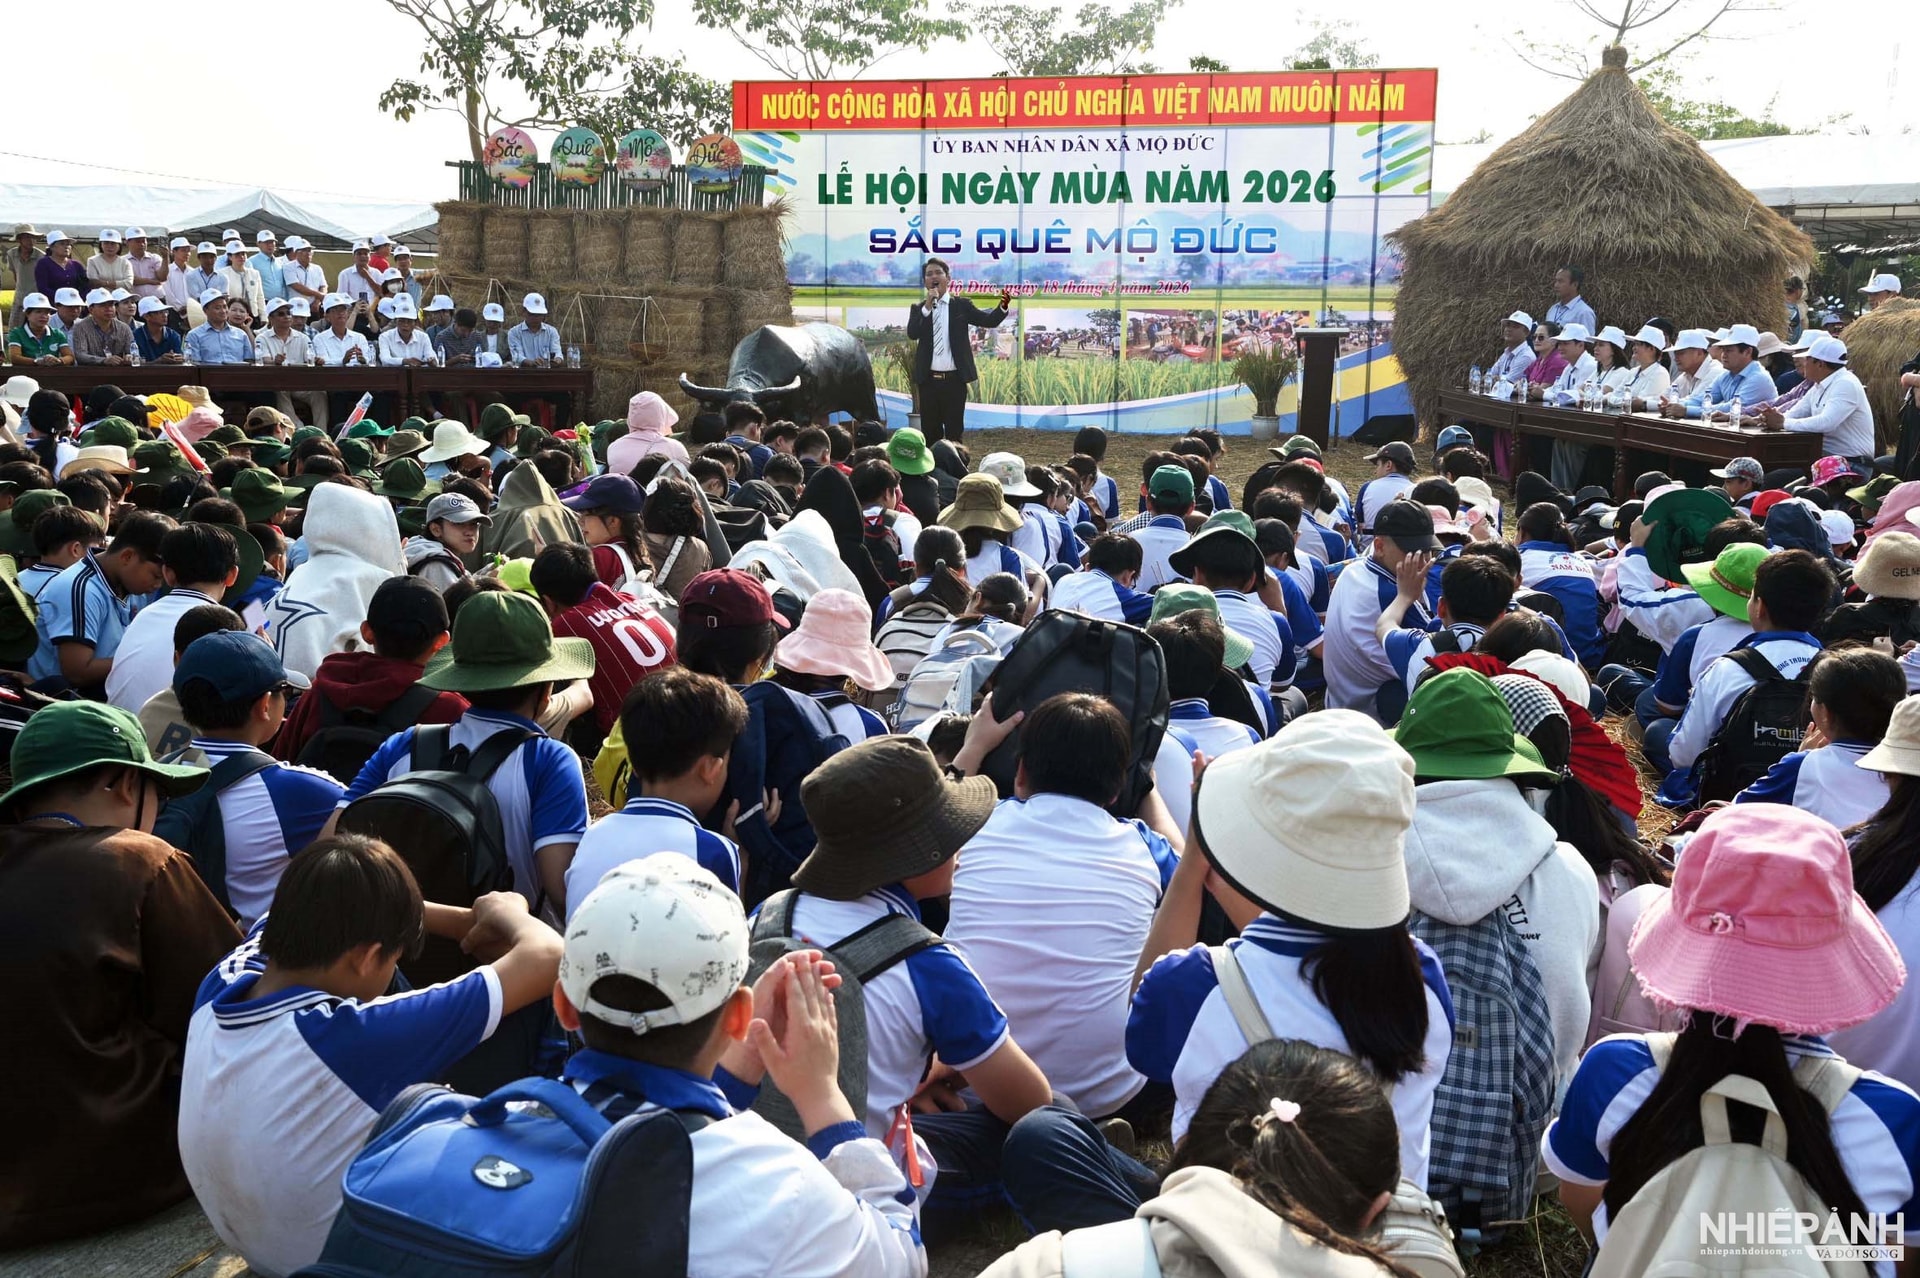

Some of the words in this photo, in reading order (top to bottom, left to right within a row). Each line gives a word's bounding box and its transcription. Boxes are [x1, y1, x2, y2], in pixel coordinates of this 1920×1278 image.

[762, 89, 820, 119] NƯỚC
[827, 88, 885, 124] CỘNG
[893, 87, 936, 118] HÒA
[943, 87, 973, 117] XÃ
[979, 86, 1016, 122] HỘI
[1024, 82, 1067, 116] CHỦ
[1076, 83, 1145, 116] NGHĨA
[1152, 82, 1201, 120] VIỆT
[1208, 86, 1262, 113] NAM
[1270, 80, 1341, 113] MUÔN
[1348, 78, 1405, 111] NĂM
[491, 132, 523, 158] Sắc
[557, 137, 594, 156] Quê
[629, 136, 655, 165] Mộ
[689, 137, 725, 166] Đức
[933, 137, 957, 154] ỦY
[962, 140, 999, 154] BAN
[1004, 135, 1056, 153] NHÂN
[1061, 135, 1100, 152] DÂN
[1105, 135, 1131, 152] XÃ
[1137, 134, 1168, 155] MỘ
[1173, 134, 1215, 151] ĐỨC
[818, 161, 853, 205] LỄ
[866, 166, 928, 213] HỘI
[942, 166, 1041, 204] NGÀY
[1049, 163, 1133, 204] MÙA
[1145, 164, 1230, 203] NĂM
[1243, 169, 1336, 203] 2026
[869, 215, 962, 254] SẮC
[976, 219, 1072, 259] QUÊ
[1086, 218, 1158, 263] MỘ
[1170, 218, 1277, 254] ĐỨC
[967, 280, 1000, 296] Đức,
[1005, 280, 1038, 297] ngày
[1042, 280, 1058, 294] 18
[1062, 280, 1102, 297] tháng
[1107, 281, 1115, 294] 4
[1120, 281, 1151, 294] năm
[1156, 280, 1191, 294] 2026
